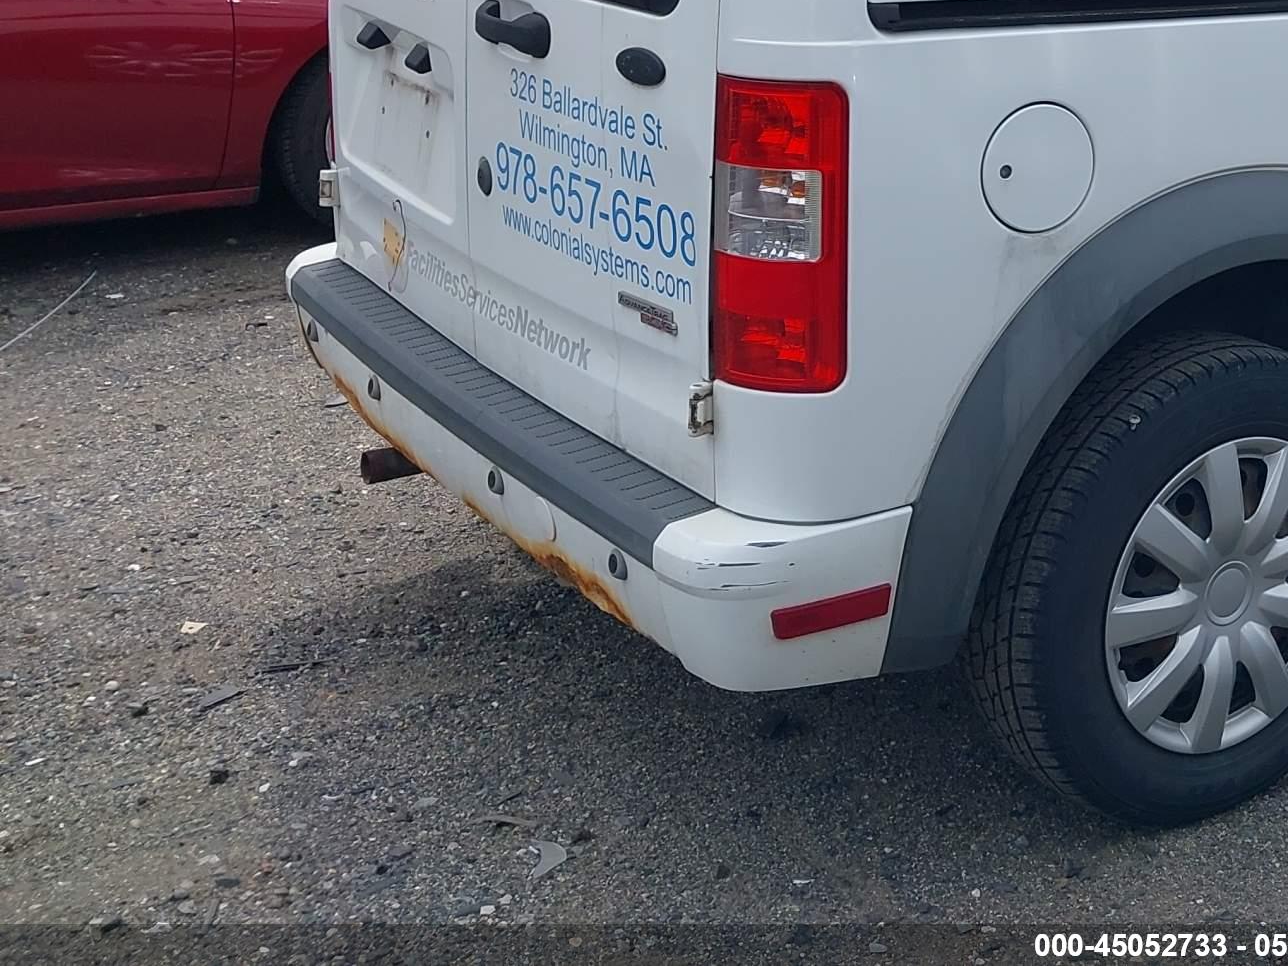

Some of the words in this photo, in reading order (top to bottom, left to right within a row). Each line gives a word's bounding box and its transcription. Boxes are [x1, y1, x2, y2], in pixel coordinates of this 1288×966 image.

[510, 68, 537, 104] 326
[542, 79, 636, 140] Ballardvale
[643, 113, 668, 151] St.
[519, 109, 614, 178] Wilmington,
[620, 146, 656, 187] MA
[496, 142, 696, 266] 978-657-6508
[502, 205, 692, 305] www.colonialsystems.com
[404, 240, 591, 371] FacilitiesServicesNetwork
